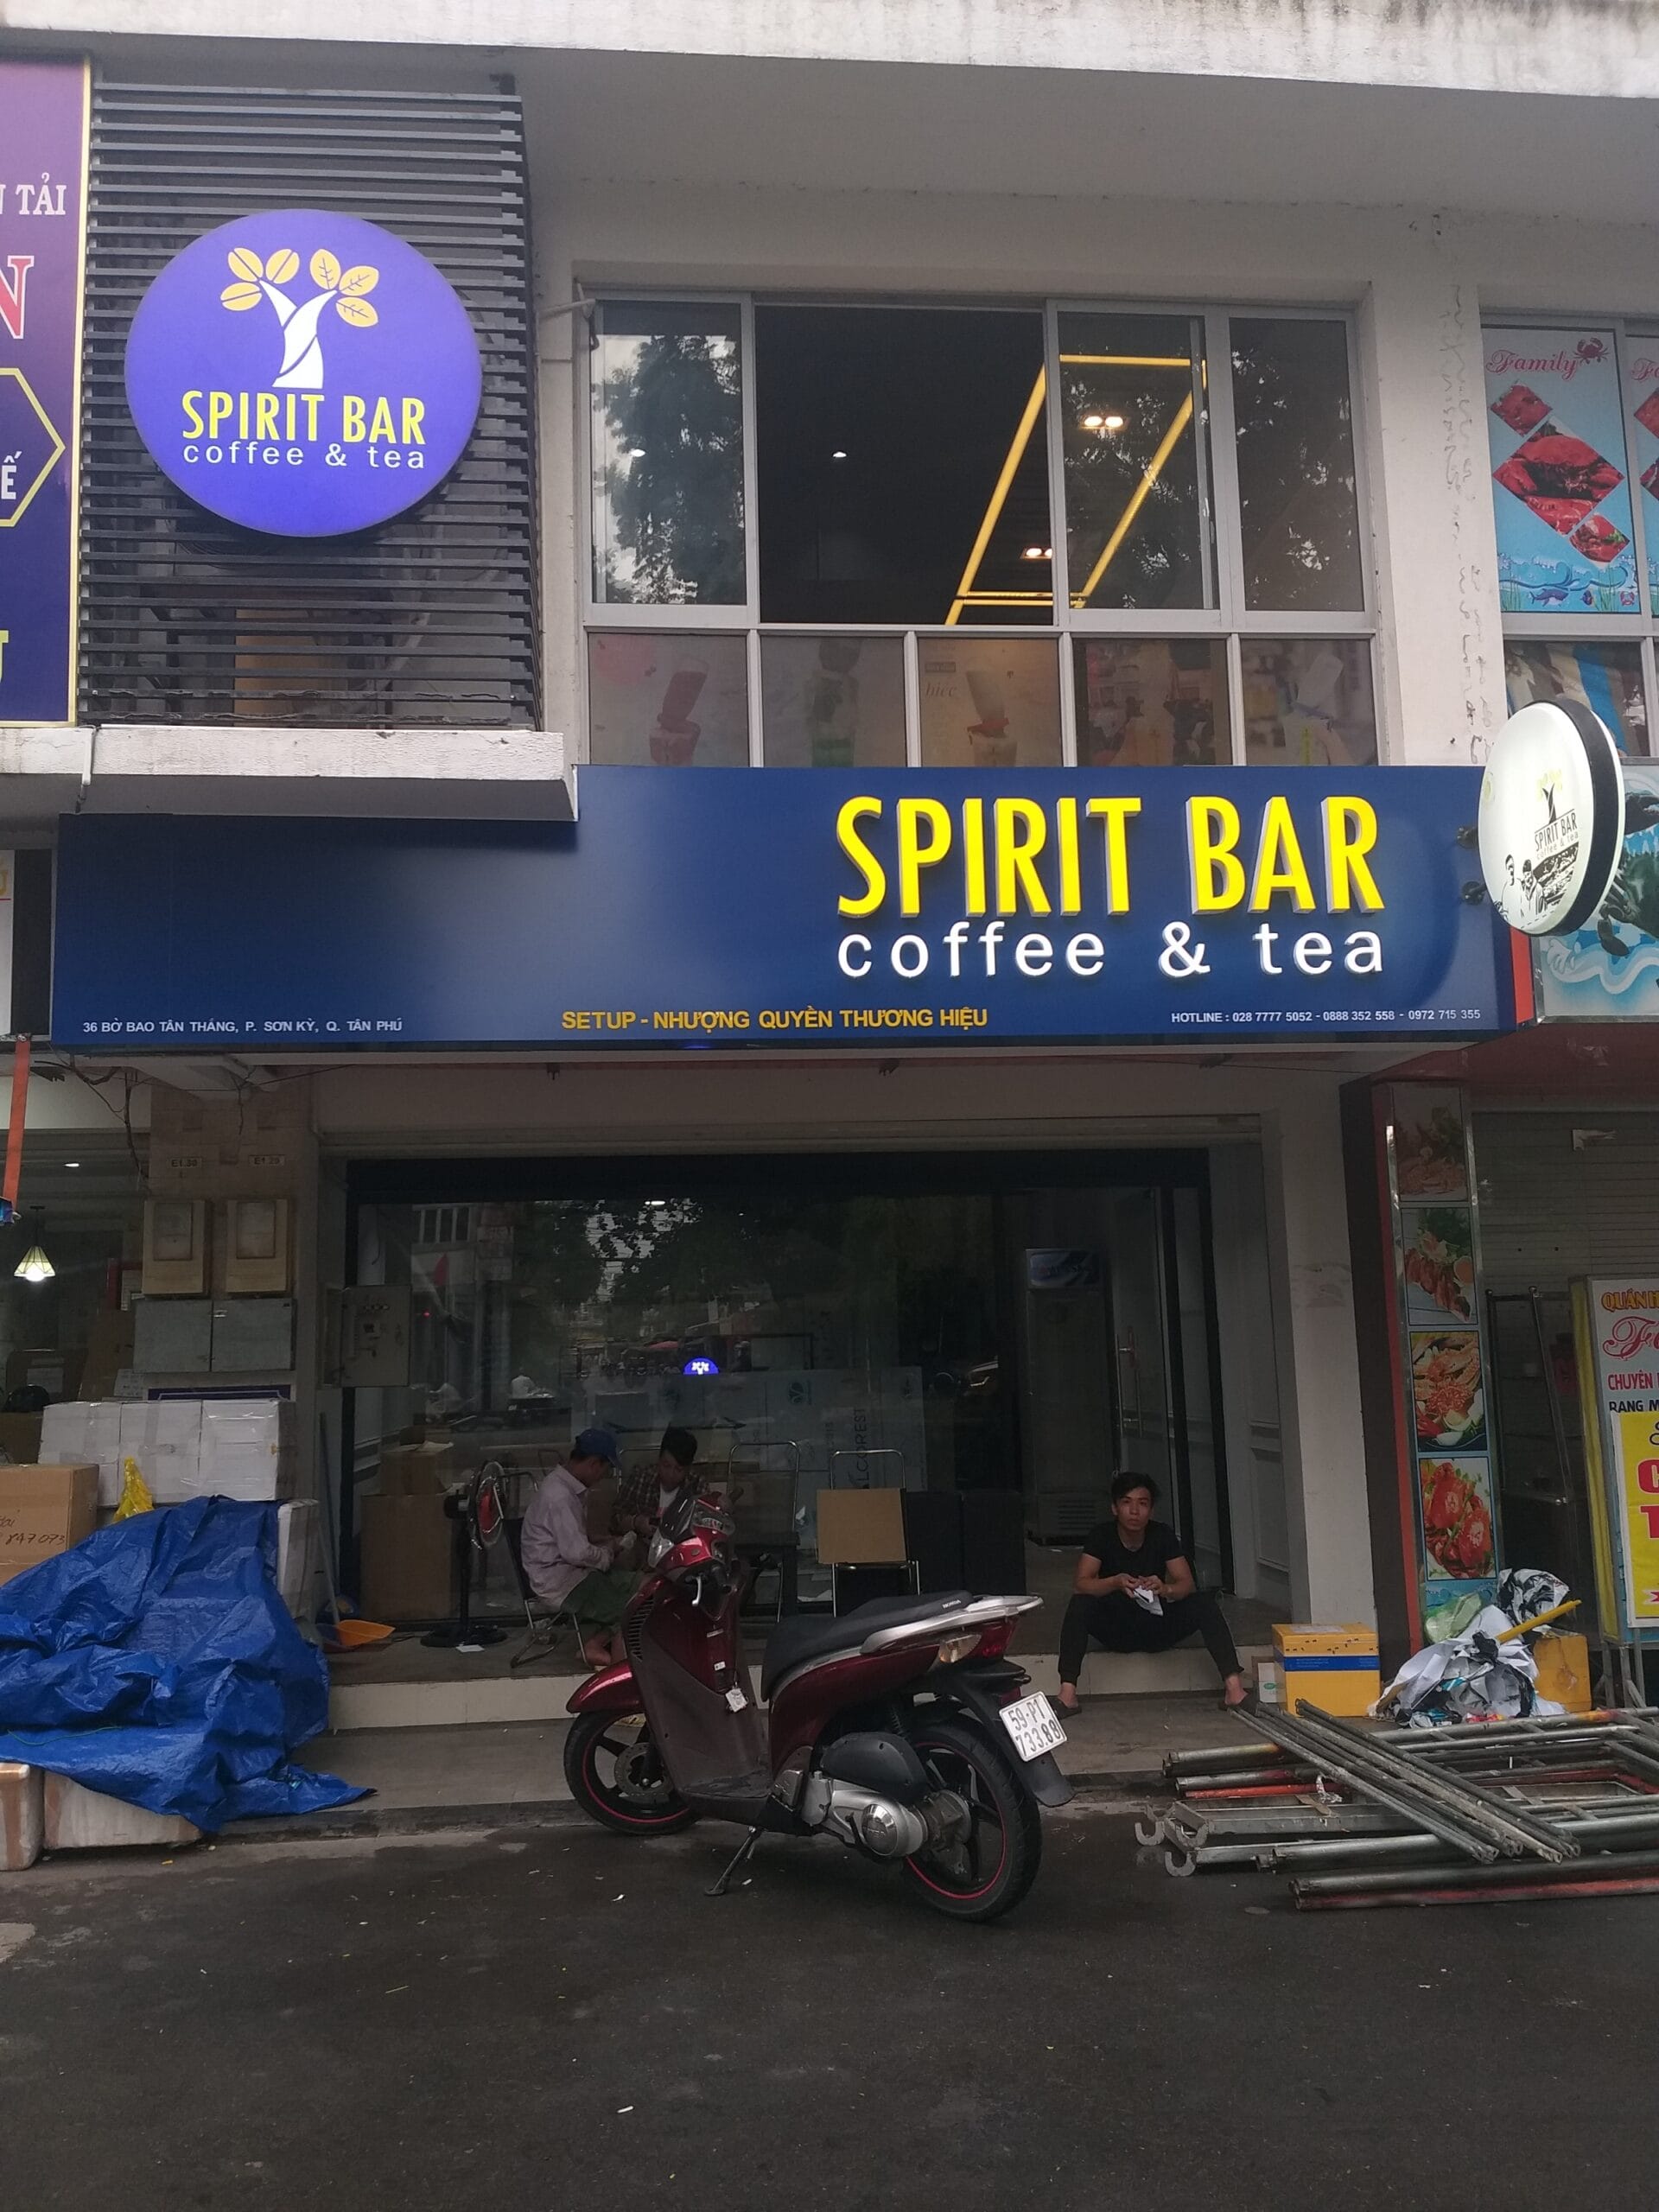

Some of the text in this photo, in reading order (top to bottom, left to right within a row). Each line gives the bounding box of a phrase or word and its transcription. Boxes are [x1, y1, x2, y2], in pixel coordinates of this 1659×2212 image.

[15, 172, 67, 215] TẢI
[1485, 349, 1577, 381] Family
[181, 390, 426, 445] SPIRIT BAR
[183, 441, 424, 468] coffee & tea
[1535, 812, 1578, 852] SPIRIT BAR
[836, 796, 1385, 918] SPIRIT BAR
[836, 920, 1383, 979] coffee & tea
[82, 1021, 98, 1033] 36
[101, 1018, 123, 1033] BỜ
[126, 1020, 155, 1032] BAO
[159, 1019, 184, 1032] TÂN
[245, 1021, 257, 1032] P.
[326, 1020, 341, 1032] Q.
[346, 1019, 372, 1032] TÂN
[376, 1017, 403, 1031] PHÚ
[562, 1011, 635, 1030] SETUP
[653, 1009, 750, 1033] NHƯỢNG
[759, 1005, 833, 1031] QUYỀN
[840, 1008, 934, 1028] THƯƠNG
[939, 1007, 988, 1031] HIỆU
[1171, 1012, 1223, 1023] HOTLINE
[1232, 1012, 1253, 1023] 028
[1255, 1012, 1282, 1022] 7777
[1285, 1011, 1313, 1022] 5052
[1323, 1011, 1349, 1021] 0888
[1351, 1010, 1372, 1021] 352
[1375, 1010, 1395, 1020] 558
[1408, 1009, 1434, 1020] 0972
[1438, 1009, 1457, 1020] 715
[1460, 1009, 1481, 1020] 355
[1601, 1287, 1648, 1313] QUÁN
[1015, 1719, 1061, 1757] 733.88
